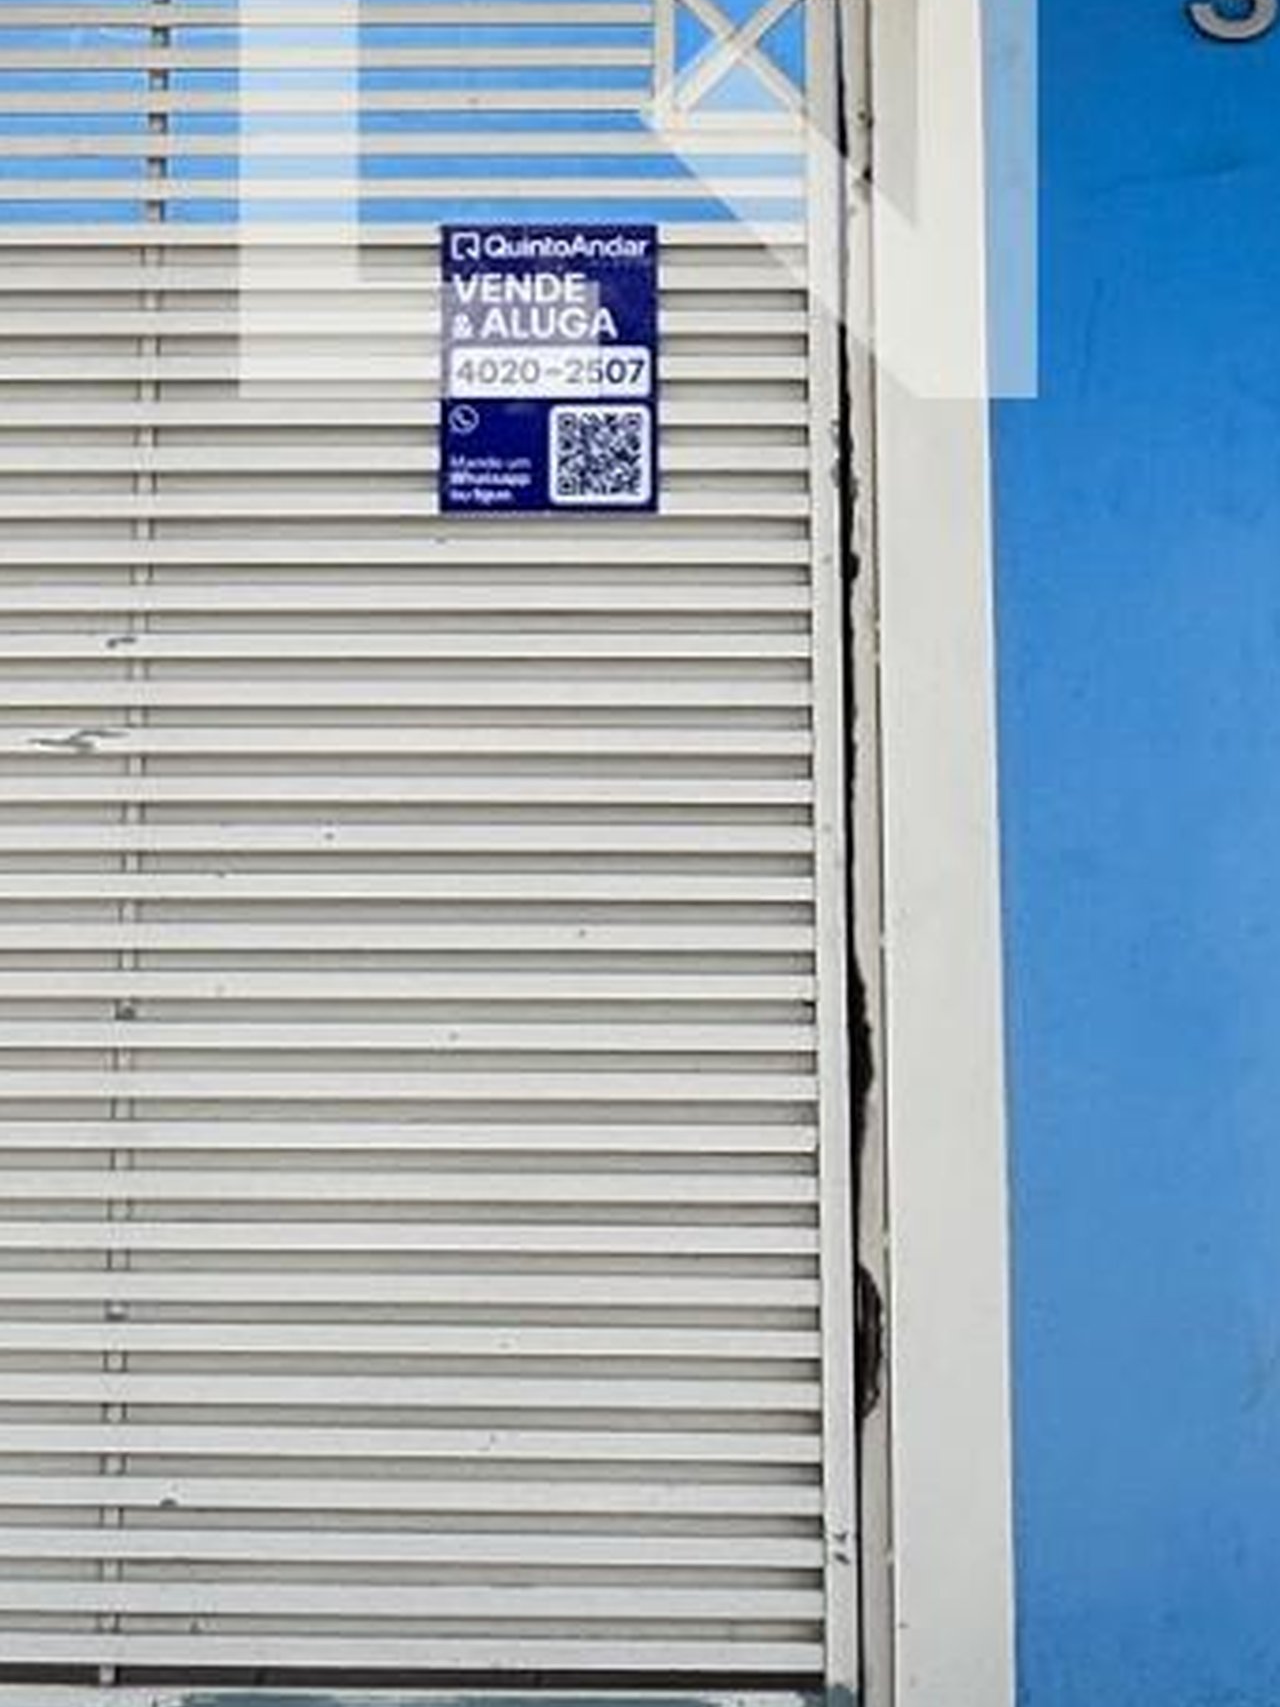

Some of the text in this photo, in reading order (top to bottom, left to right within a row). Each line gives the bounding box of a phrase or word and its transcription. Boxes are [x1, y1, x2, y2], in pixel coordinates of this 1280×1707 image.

[484, 233, 650, 258] QuintoAndar
[451, 273, 587, 303] VENDE
[452, 307, 619, 339] & ALUGA
[455, 358, 645, 385] 4020-2507
